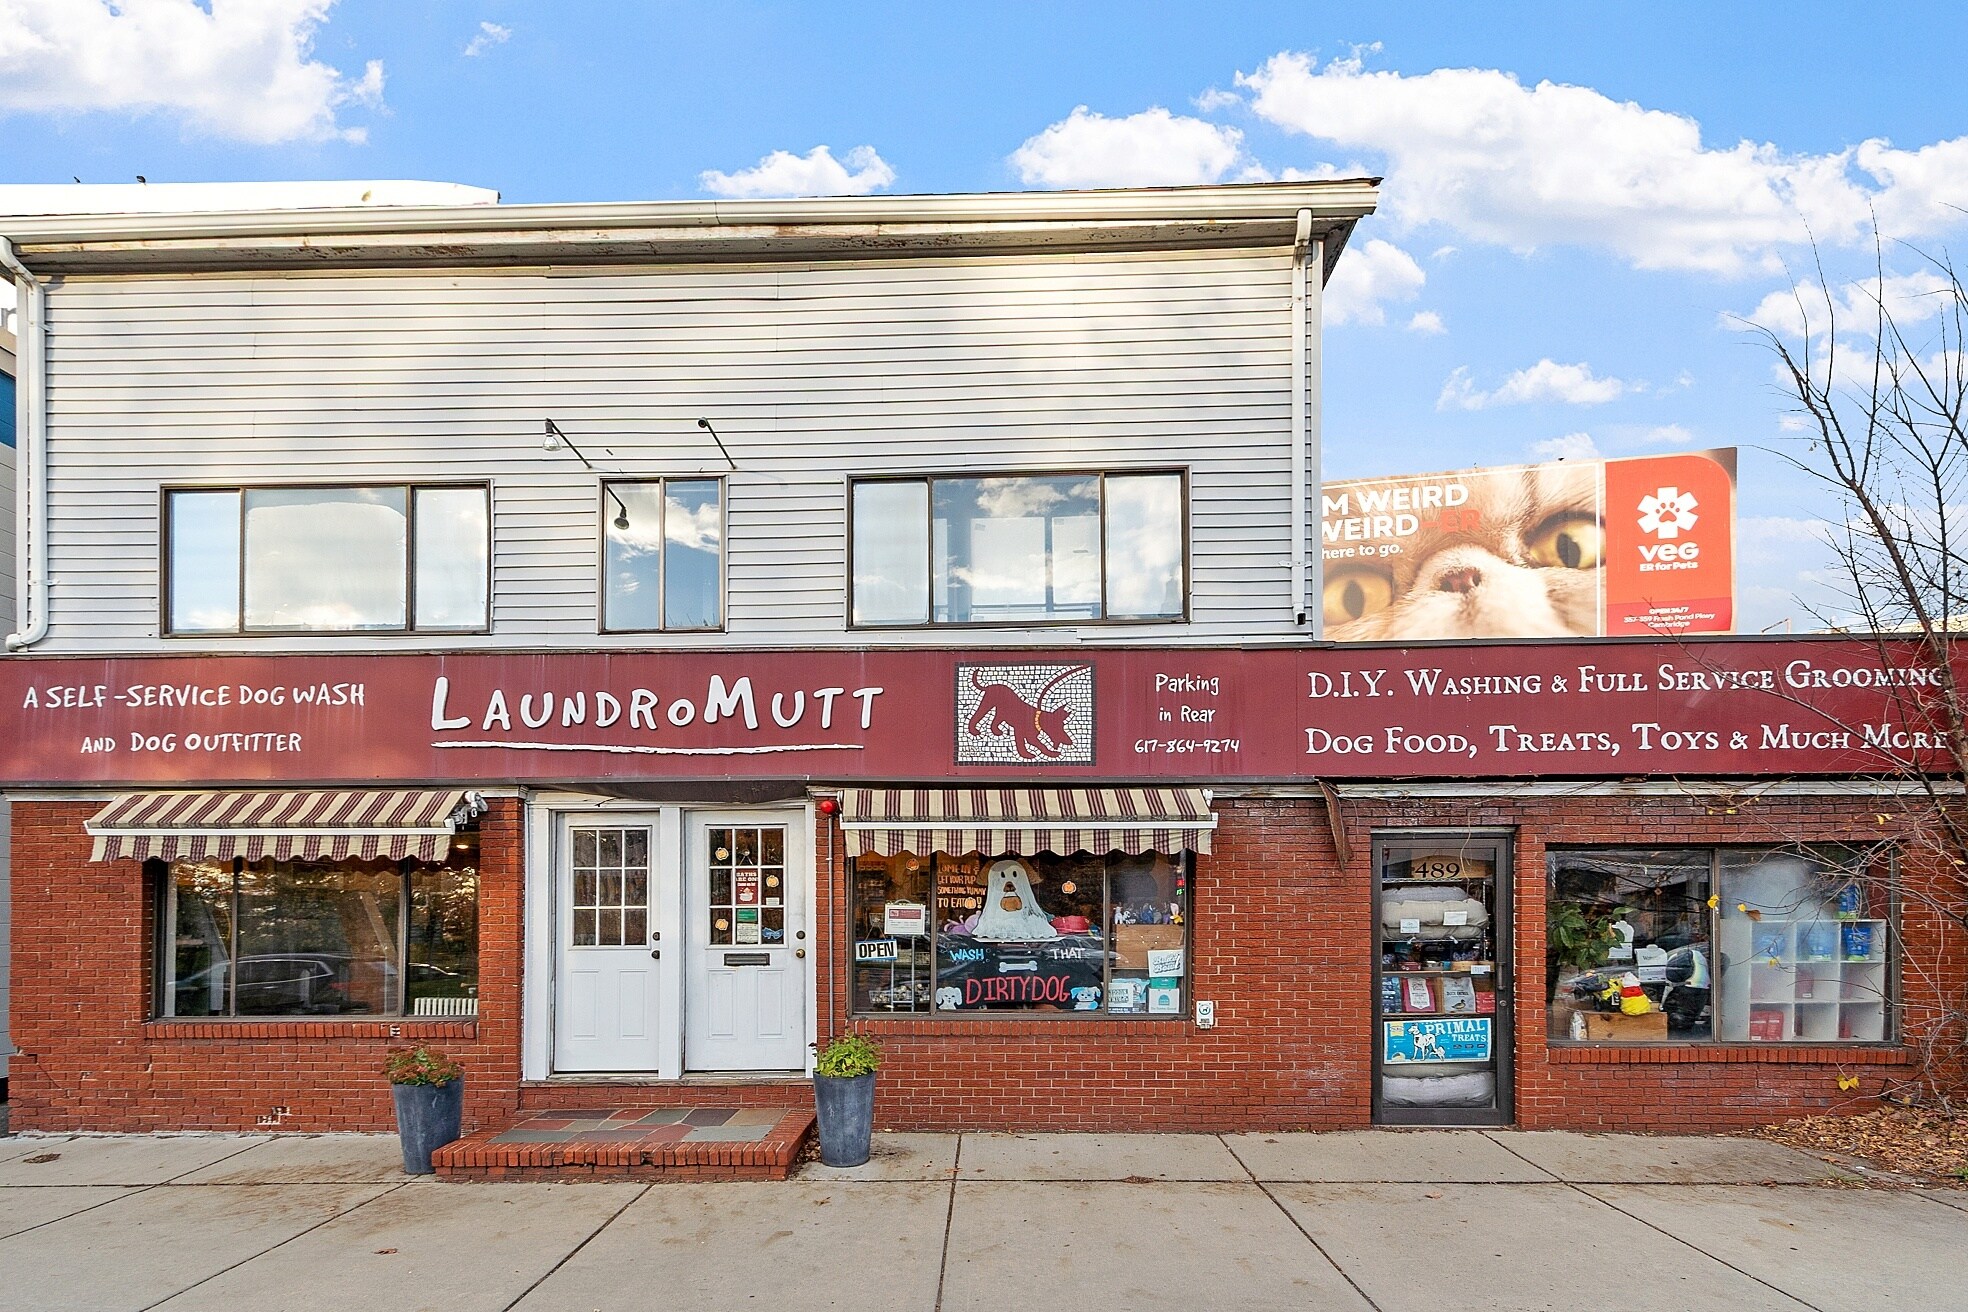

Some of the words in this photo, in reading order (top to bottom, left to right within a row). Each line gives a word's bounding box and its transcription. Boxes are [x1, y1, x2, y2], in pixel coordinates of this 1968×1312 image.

[1356, 484, 1469, 513] WEIRD
[1359, 545, 1375, 556] to
[1379, 544, 1403, 557] go.
[1639, 563, 1654, 572] ER
[1655, 562, 1672, 571] for
[1672, 561, 1698, 570] Pets
[1155, 673, 1220, 696] Parking
[1308, 669, 1394, 698] D.I.Y.
[1403, 668, 1542, 696] WASHING
[1551, 674, 1568, 693] &
[1578, 665, 1648, 693] FULL
[1658, 664, 1774, 692] SERVICE
[23, 686, 39, 708] A
[239, 684, 286, 706] DOG
[292, 683, 366, 706] WASH
[1159, 706, 1171, 722] in
[1180, 706, 1216, 723] Rear
[81, 736, 116, 754] AND
[130, 732, 177, 753] DOG
[184, 733, 302, 752] OUTFITTER
[1134, 738, 1240, 754] 617-864-9274
[1304, 727, 1373, 755] DOG
[1384, 726, 1478, 759] FOOD,
[1488, 725, 1620, 757] TREATS,
[1632, 722, 1719, 750] TOYS
[1729, 731, 1749, 750] &
[1758, 723, 1850, 749] MUCH
[1860, 723, 1948, 750] MORE
[1415, 862, 1460, 879] 489
[964, 875, 976, 884] PUP
[937, 897, 949, 908] TO
[858, 941, 894, 958] OPEN
[950, 948, 984, 961] WASH
[1050, 947, 1086, 960] THAT
[965, 976, 1030, 1005] DIRTY
[1031, 975, 1070, 1002] DOG
[1425, 1019, 1486, 1035] PRIMAL
[1452, 1034, 1487, 1042] TREATS
